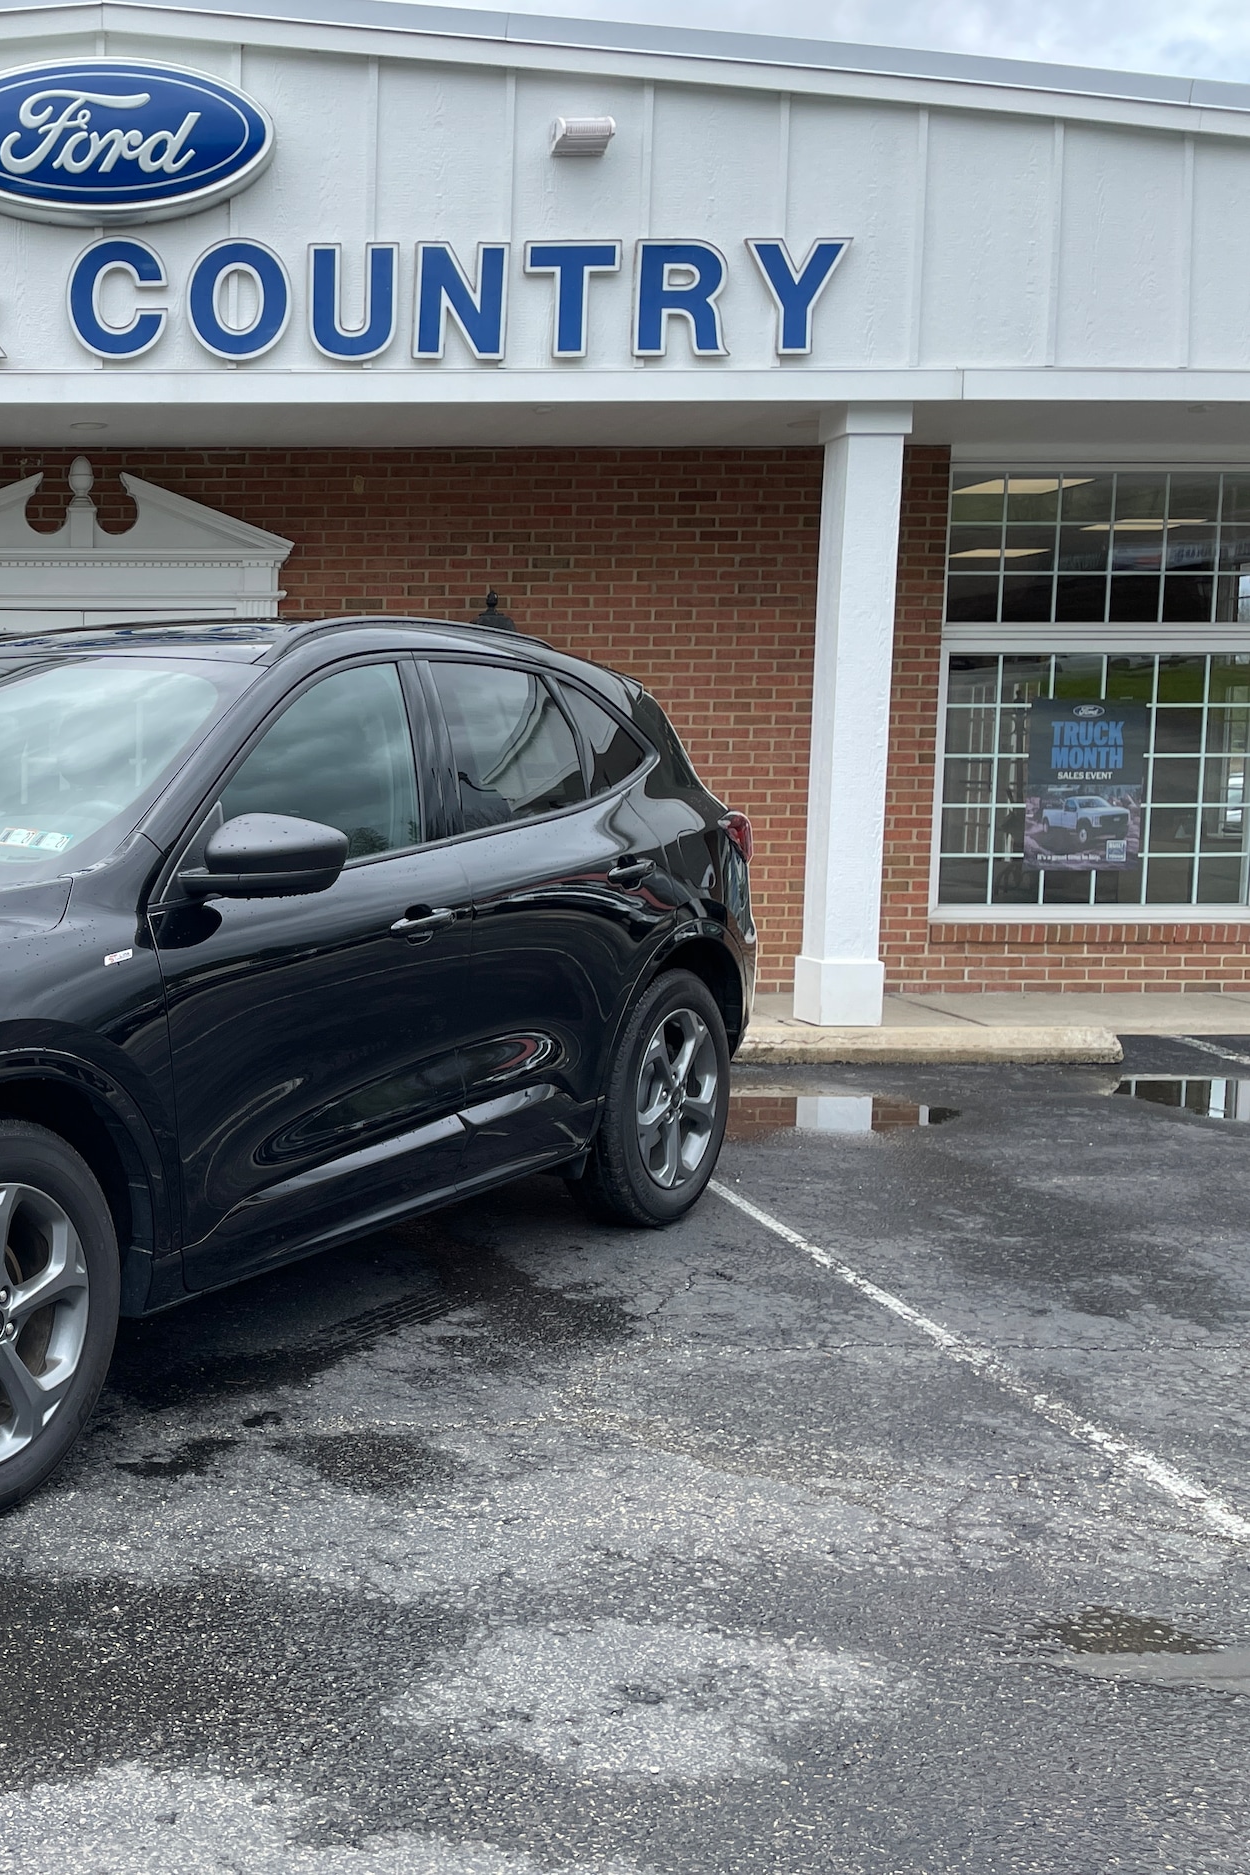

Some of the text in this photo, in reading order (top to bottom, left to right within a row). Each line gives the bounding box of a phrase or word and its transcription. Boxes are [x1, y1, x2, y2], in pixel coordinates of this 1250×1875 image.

[0, 89, 200, 174] Ford
[67, 236, 853, 360] COUNTRY
[1051, 721, 1125, 746] TRUCK
[1051, 747, 1123, 769] MONTH
[1057, 771, 1113, 780] SALES EVENT
